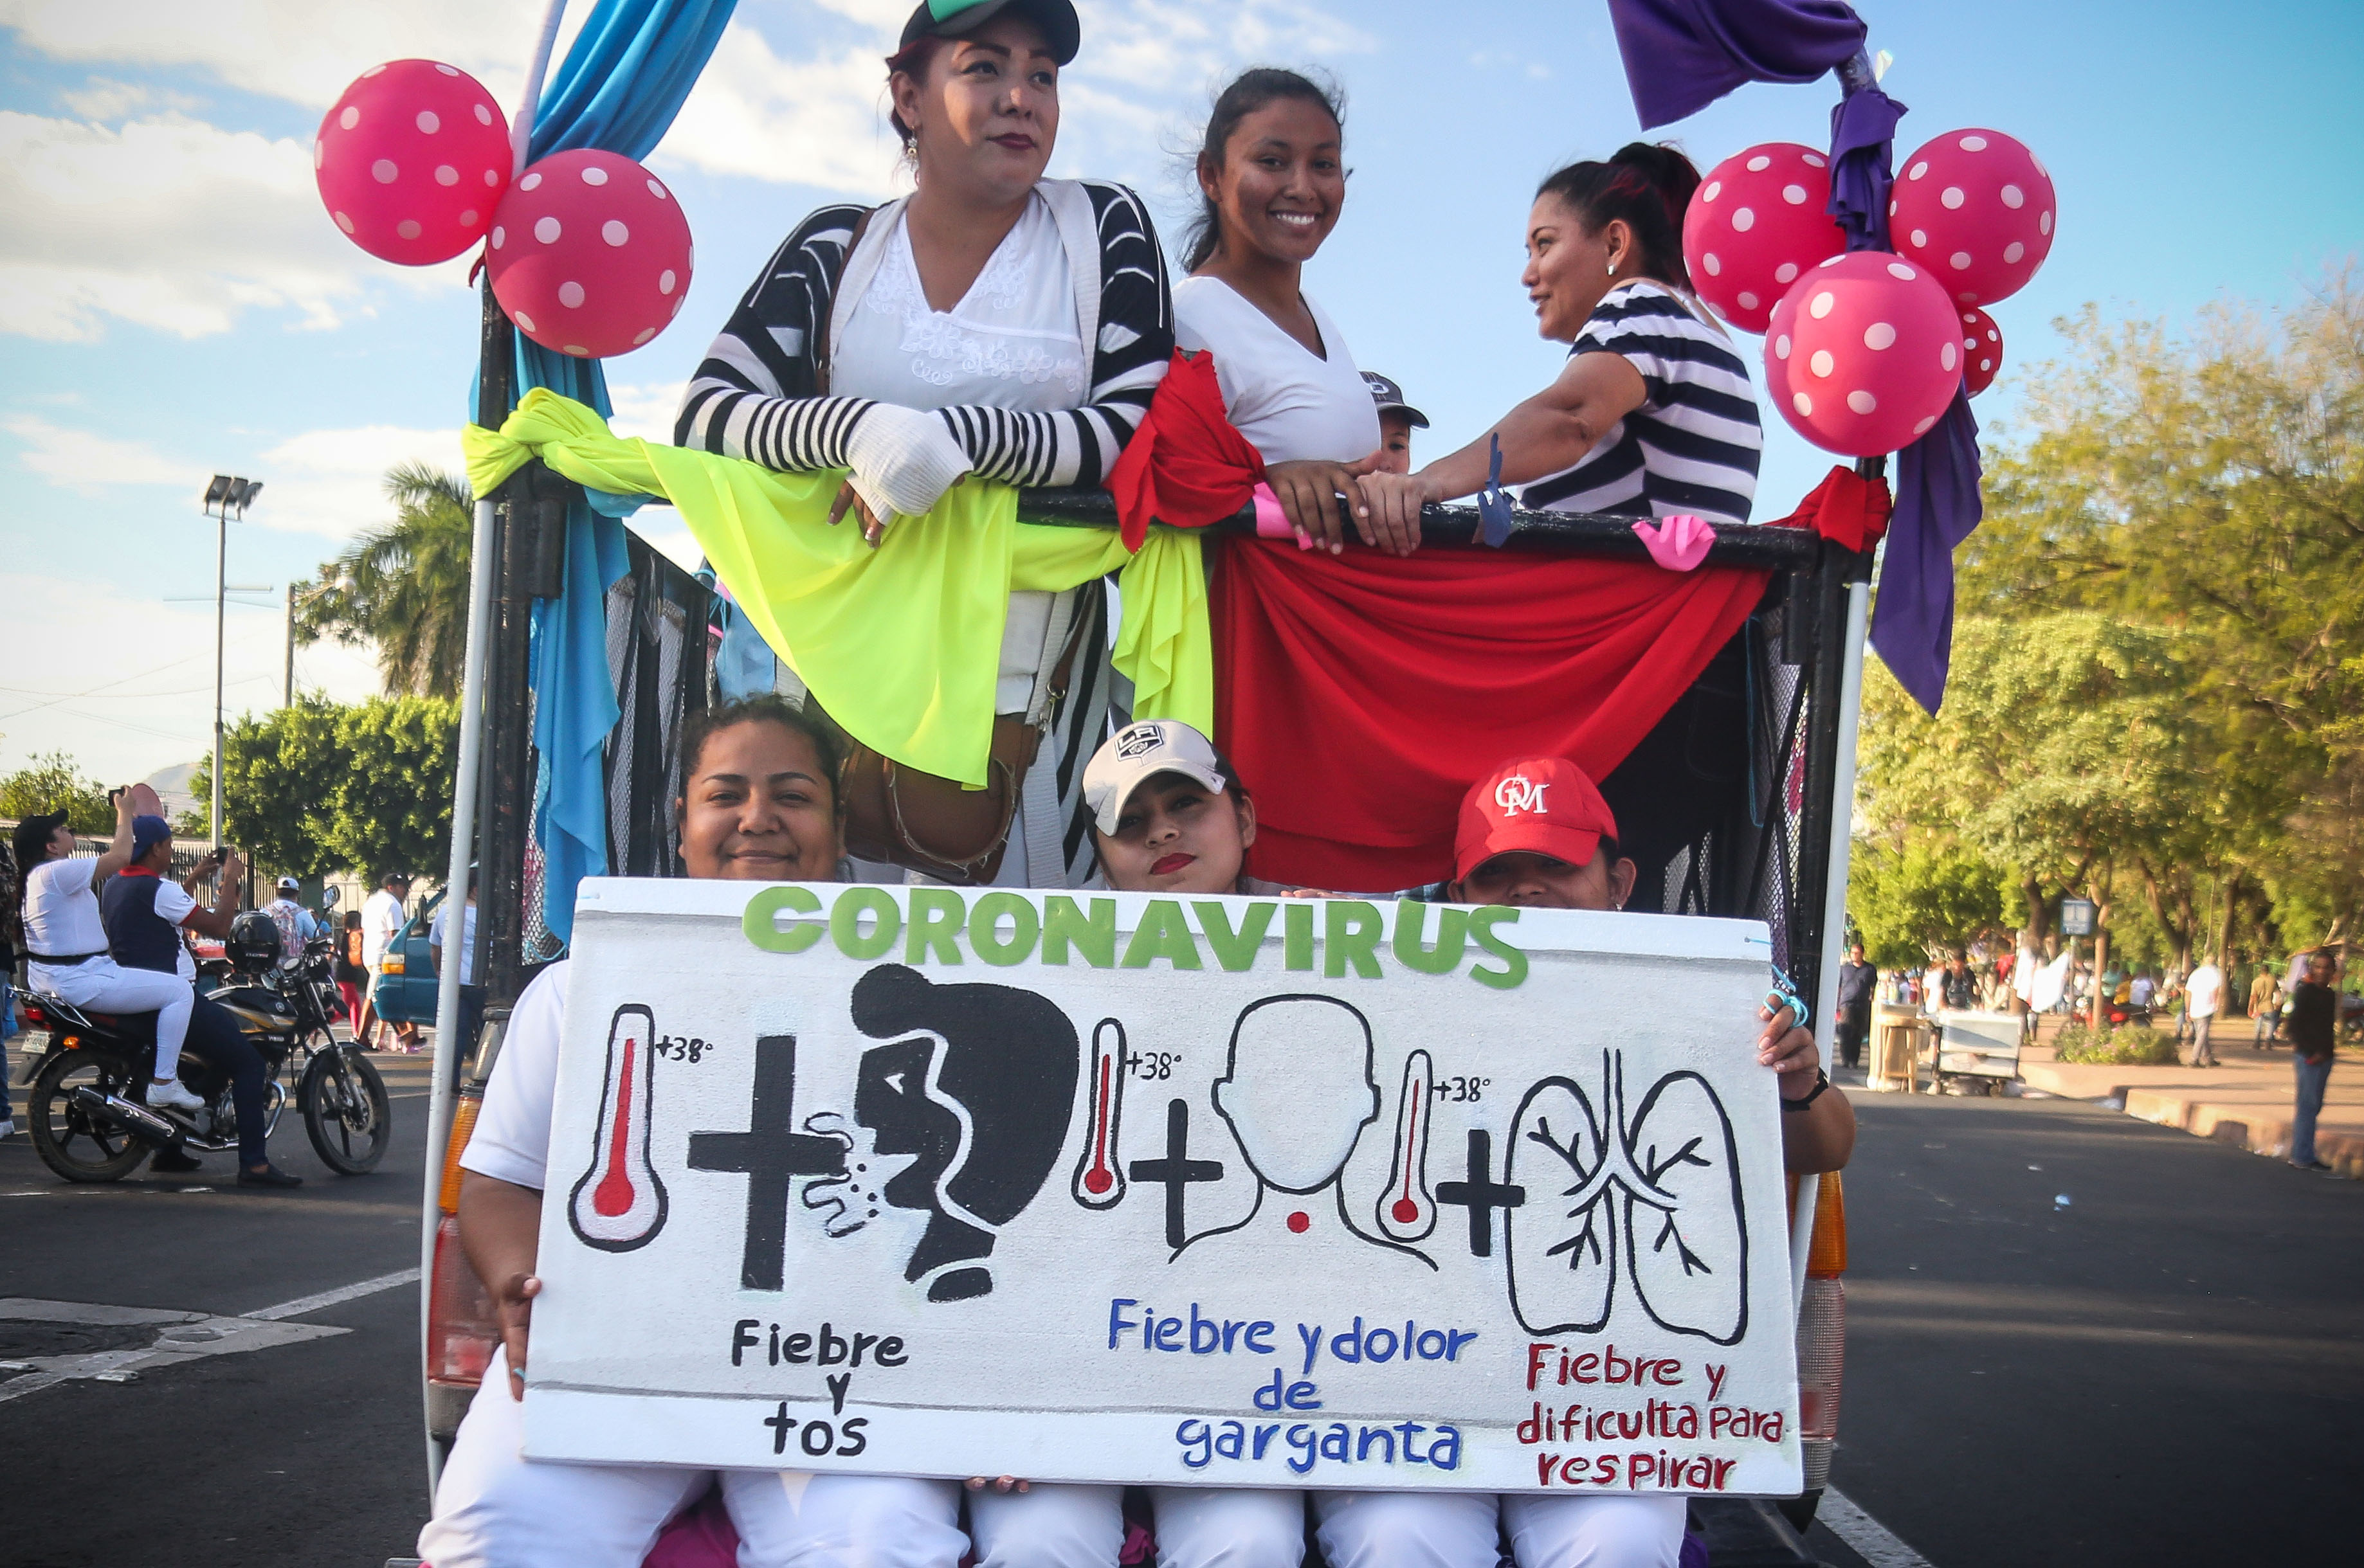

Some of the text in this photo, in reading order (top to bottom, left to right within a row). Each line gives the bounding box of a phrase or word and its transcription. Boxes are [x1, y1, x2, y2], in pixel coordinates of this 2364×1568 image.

[743, 885, 1529, 987] CORONAVIRUS
[731, 1319, 909, 1368] Fiebre
[1107, 1298, 1479, 1374] Fiebre y dolor
[826, 1372, 852, 1416] y
[1253, 1367, 1323, 1412] de
[1527, 1342, 1726, 1401] Fiebre y
[763, 1401, 869, 1457] tos
[1175, 1418, 1461, 1475] garganta
[1516, 1398, 1699, 1445] dificulta
